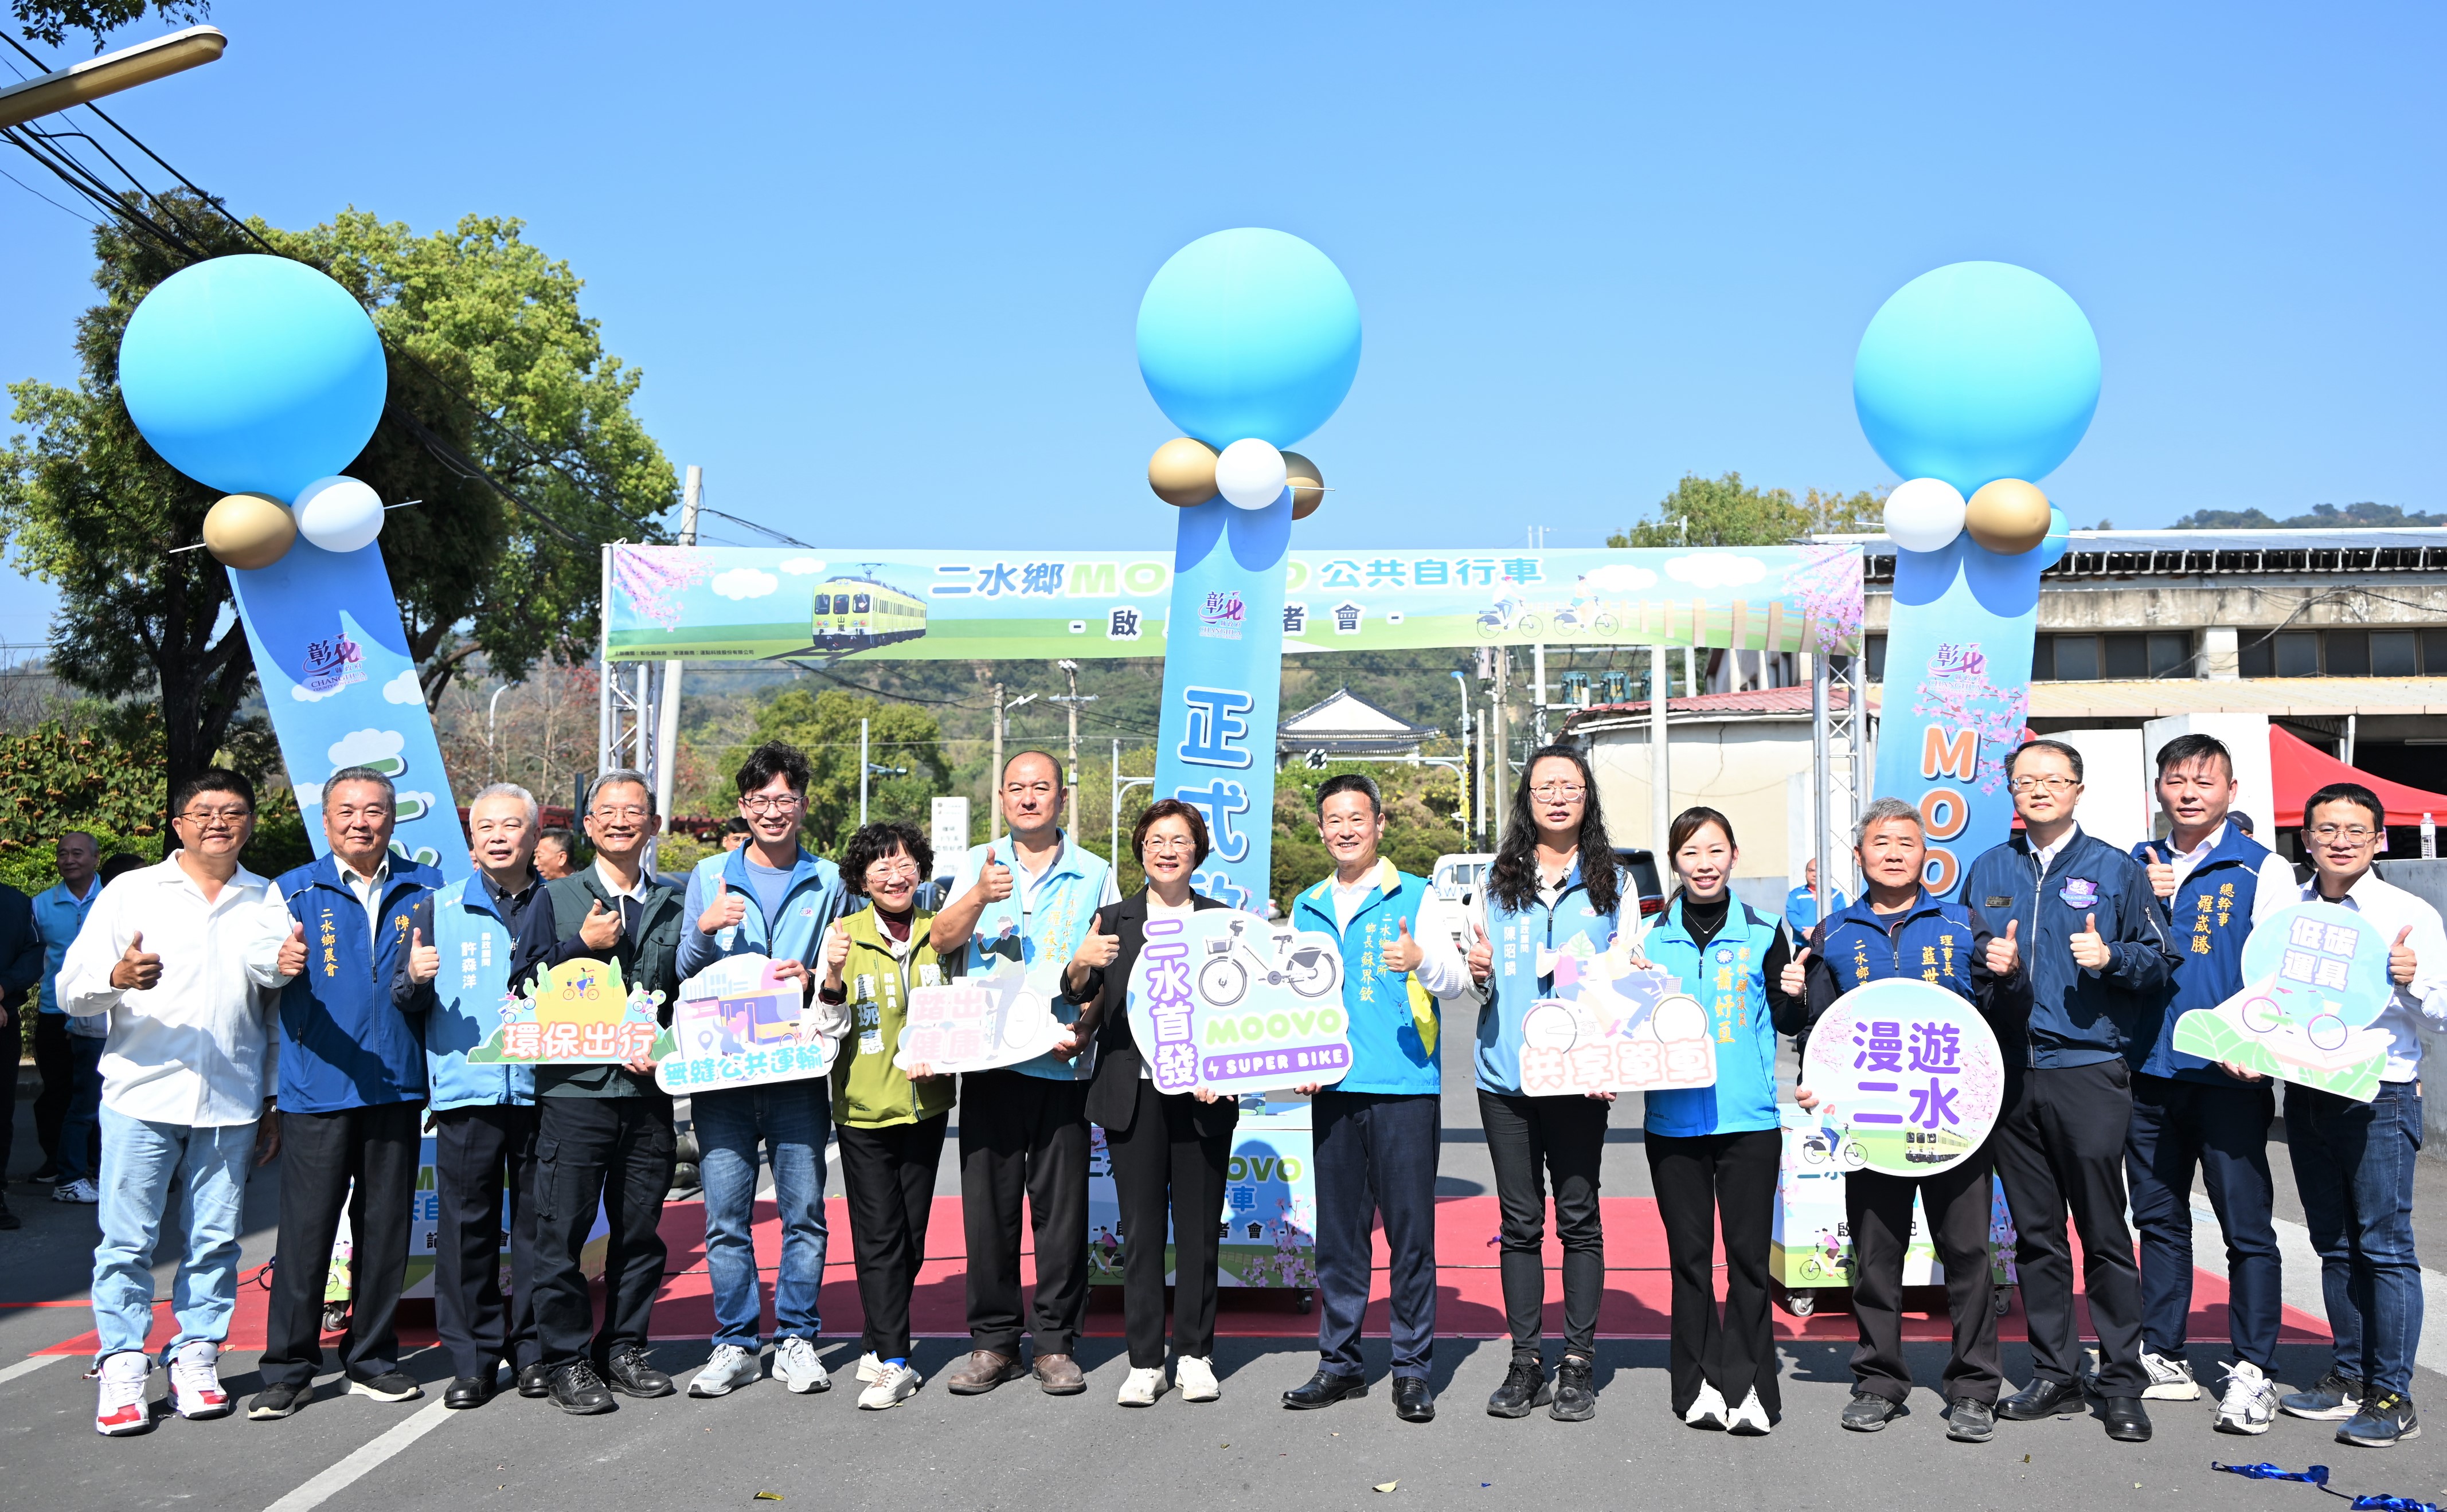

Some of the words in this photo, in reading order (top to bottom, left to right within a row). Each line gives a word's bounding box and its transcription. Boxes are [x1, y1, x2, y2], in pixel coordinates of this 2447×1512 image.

[1206, 591, 1242, 621] 彰化
[307, 640, 360, 665] 彰化
[1199, 626, 1241, 636] CHANGHUA
[311, 671, 366, 688] CHANGHUA
[1937, 643, 1983, 674] 彰化
[1928, 680, 1981, 691] CHANGHUA
[2217, 883, 2235, 927] 總幹事
[320, 908, 339, 977] 二水鄉農會
[1939, 935, 1955, 977] 理事長
[2289, 915, 2359, 959] 低碳
[460, 941, 477, 990] 許森洋
[1735, 946, 1751, 1028] 彰化縣議員
[2280, 948, 2350, 993] 運具
[884, 973, 897, 1008] 縣議員
[1145, 920, 1198, 1088] 二水首發
[853, 973, 885, 1055] 詹琬惠
[1206, 1008, 1342, 1045] MOOVO
[502, 1021, 658, 1060] 環保出行
[1226, 1054, 1289, 1075] SUPER
[1297, 1048, 1343, 1067] BIKE
[1852, 1021, 1961, 1074] 漫遊
[663, 1044, 823, 1087] 無縫公共運輸
[1525, 1039, 1711, 1090] 共享單車
[1853, 1077, 1960, 1129] 二水
